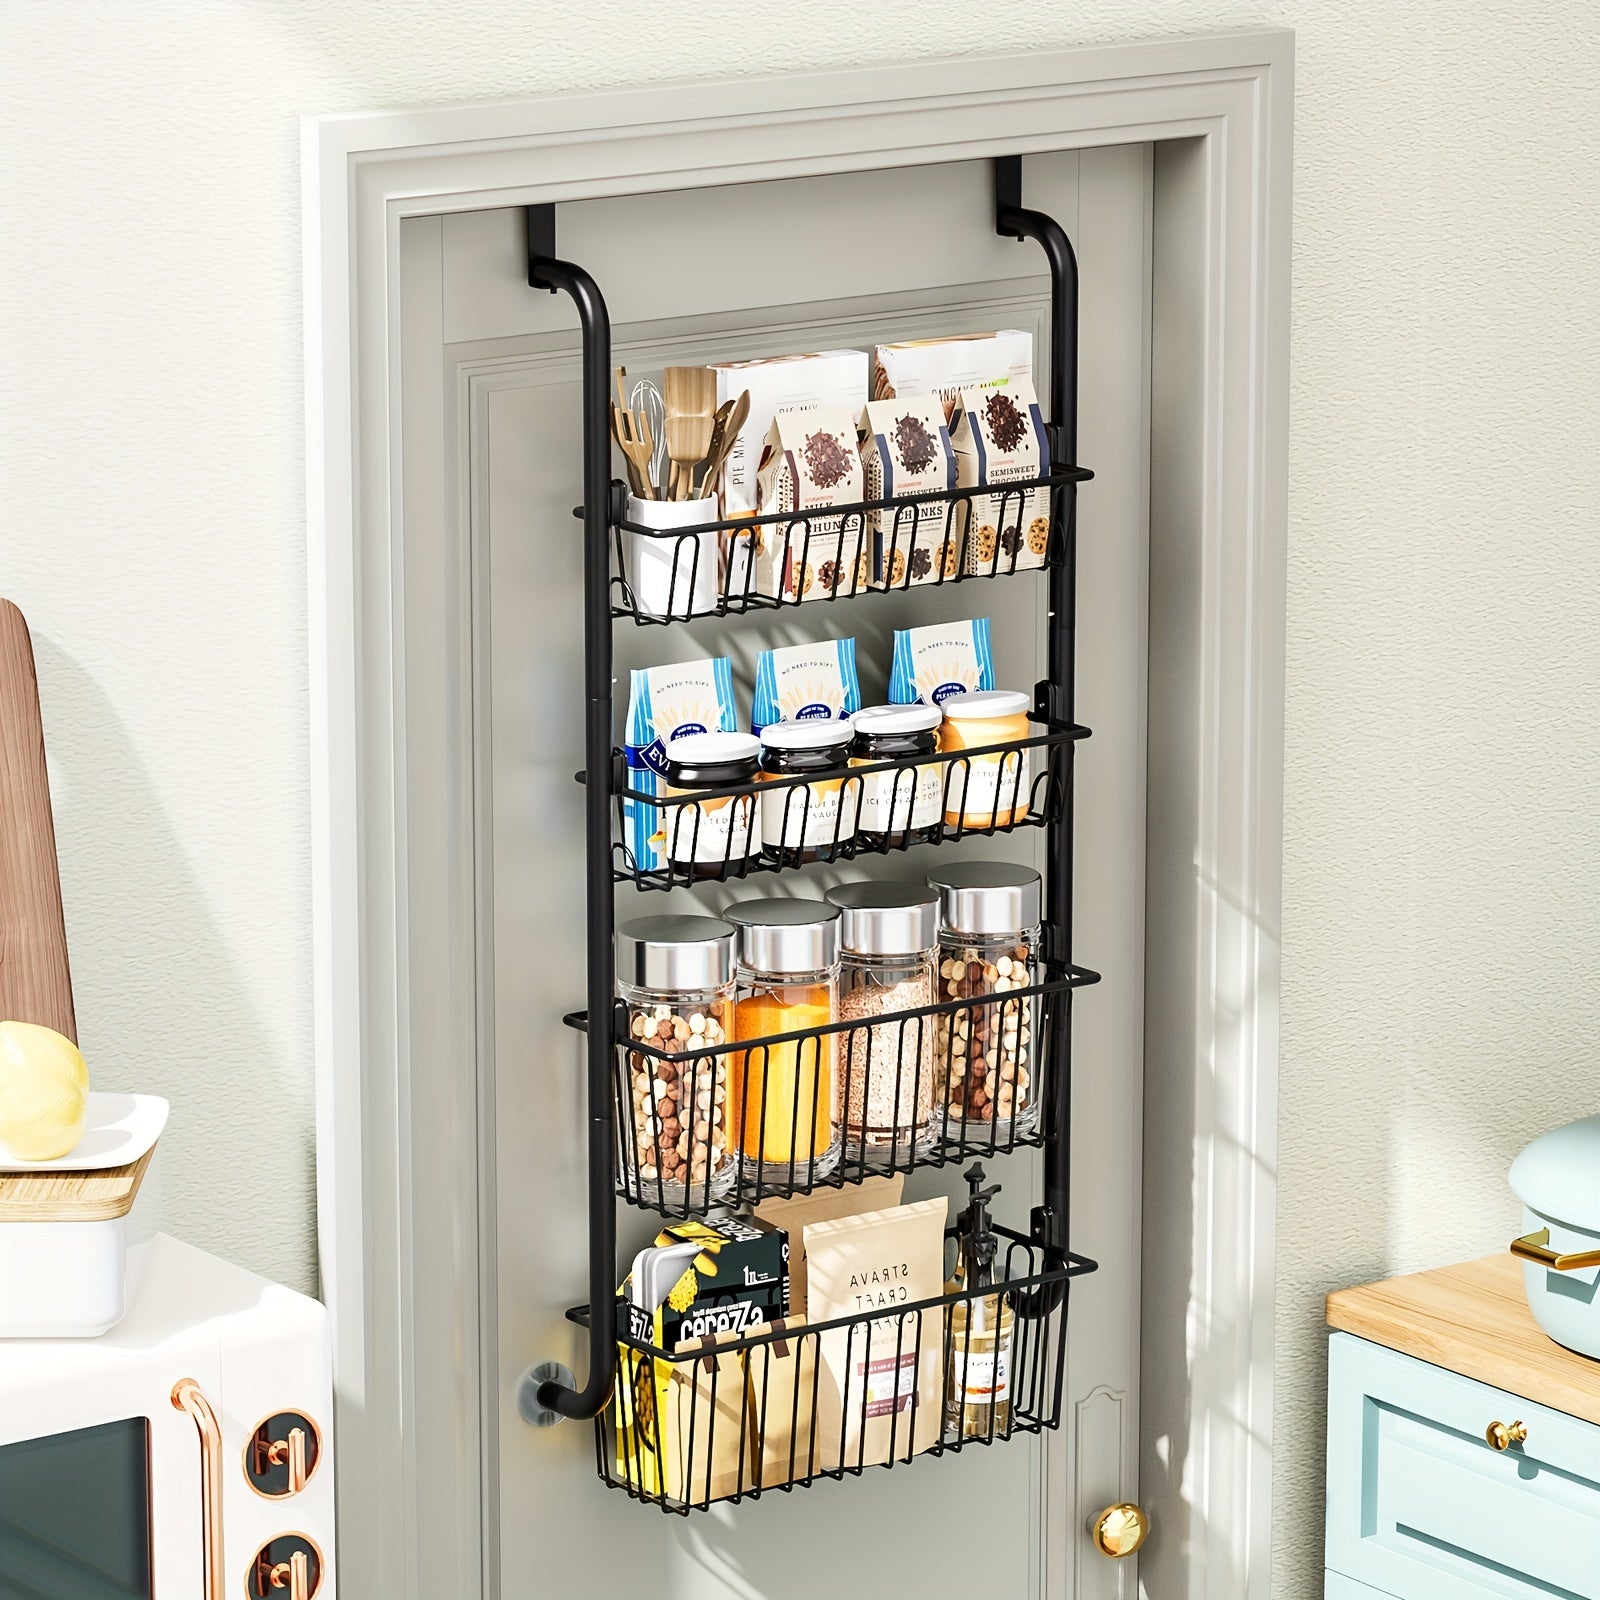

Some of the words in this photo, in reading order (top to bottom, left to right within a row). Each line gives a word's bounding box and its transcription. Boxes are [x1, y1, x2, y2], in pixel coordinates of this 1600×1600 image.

[990, 465, 1035, 477] SEMISWEET
[898, 506, 943, 520] CHNKS
[810, 518, 858, 533] HUNKS
